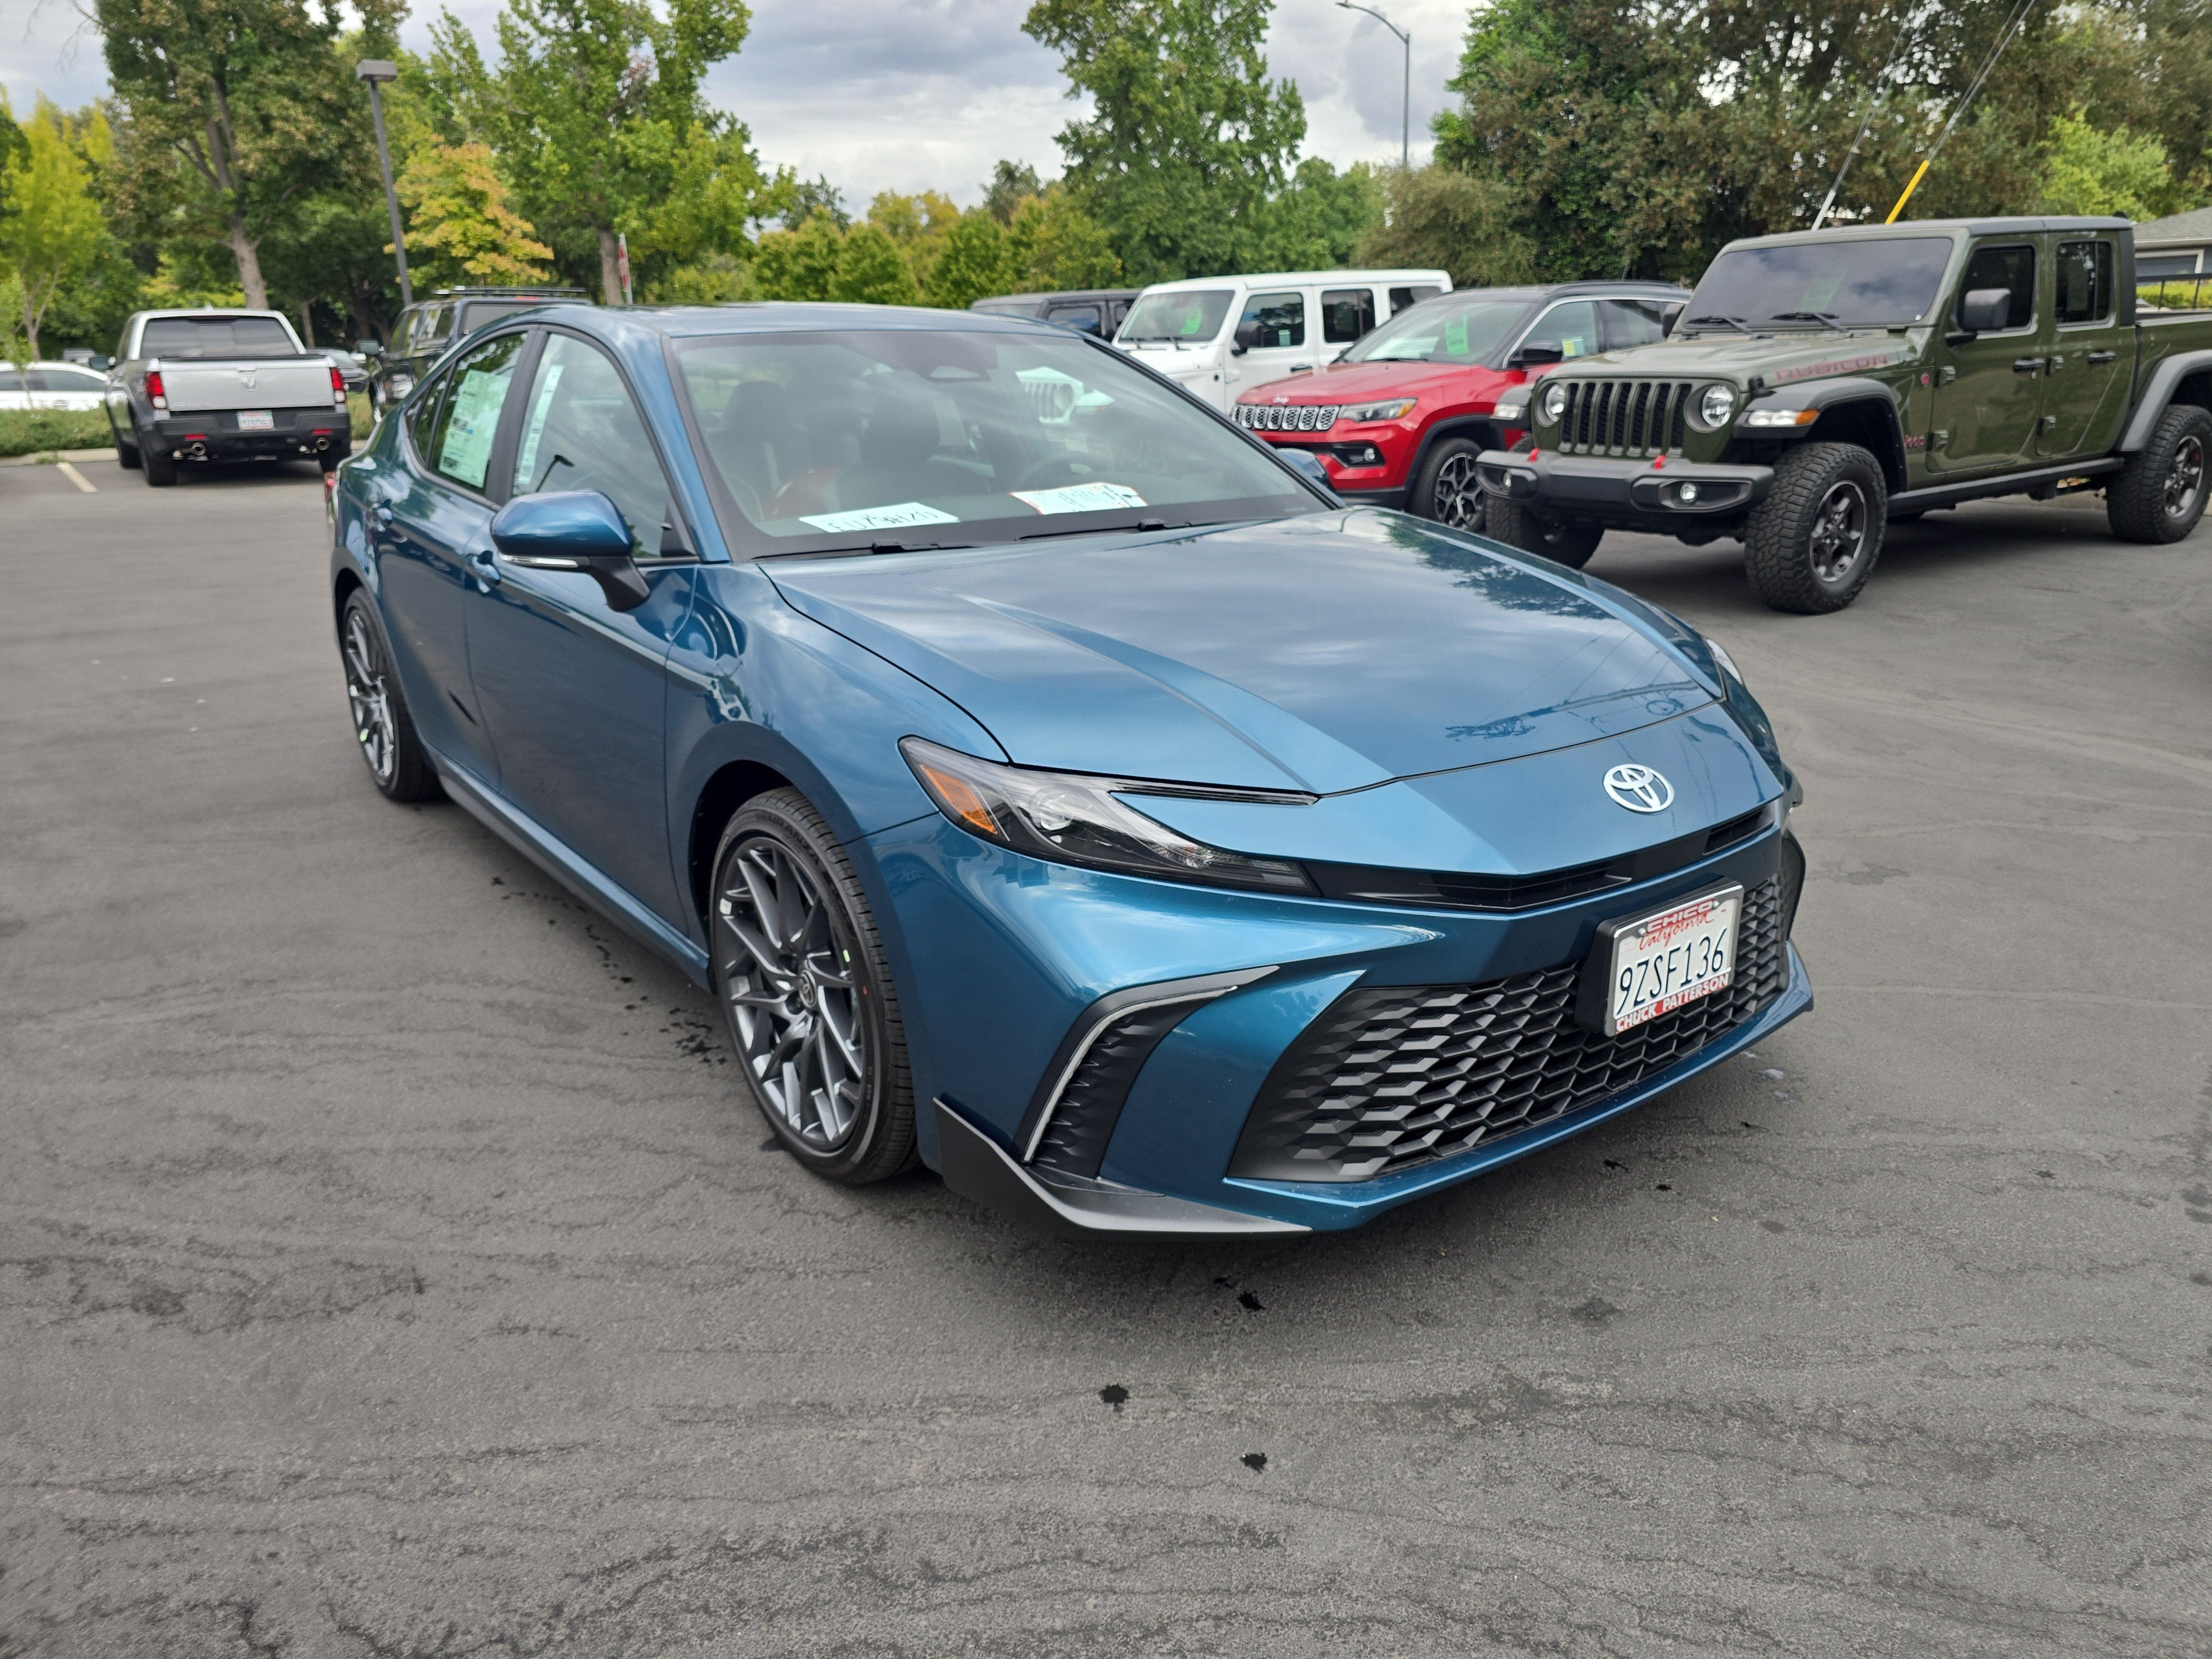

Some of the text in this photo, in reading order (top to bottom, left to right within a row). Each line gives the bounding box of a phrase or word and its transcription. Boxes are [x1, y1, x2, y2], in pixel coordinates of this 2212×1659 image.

[1773, 354, 1888, 382] RUBICON
[1647, 900, 1713, 933] CHICO
[1617, 927, 1727, 1015] 9ZSF136
[1616, 973, 1729, 1032] CHUCK PATTERSON
